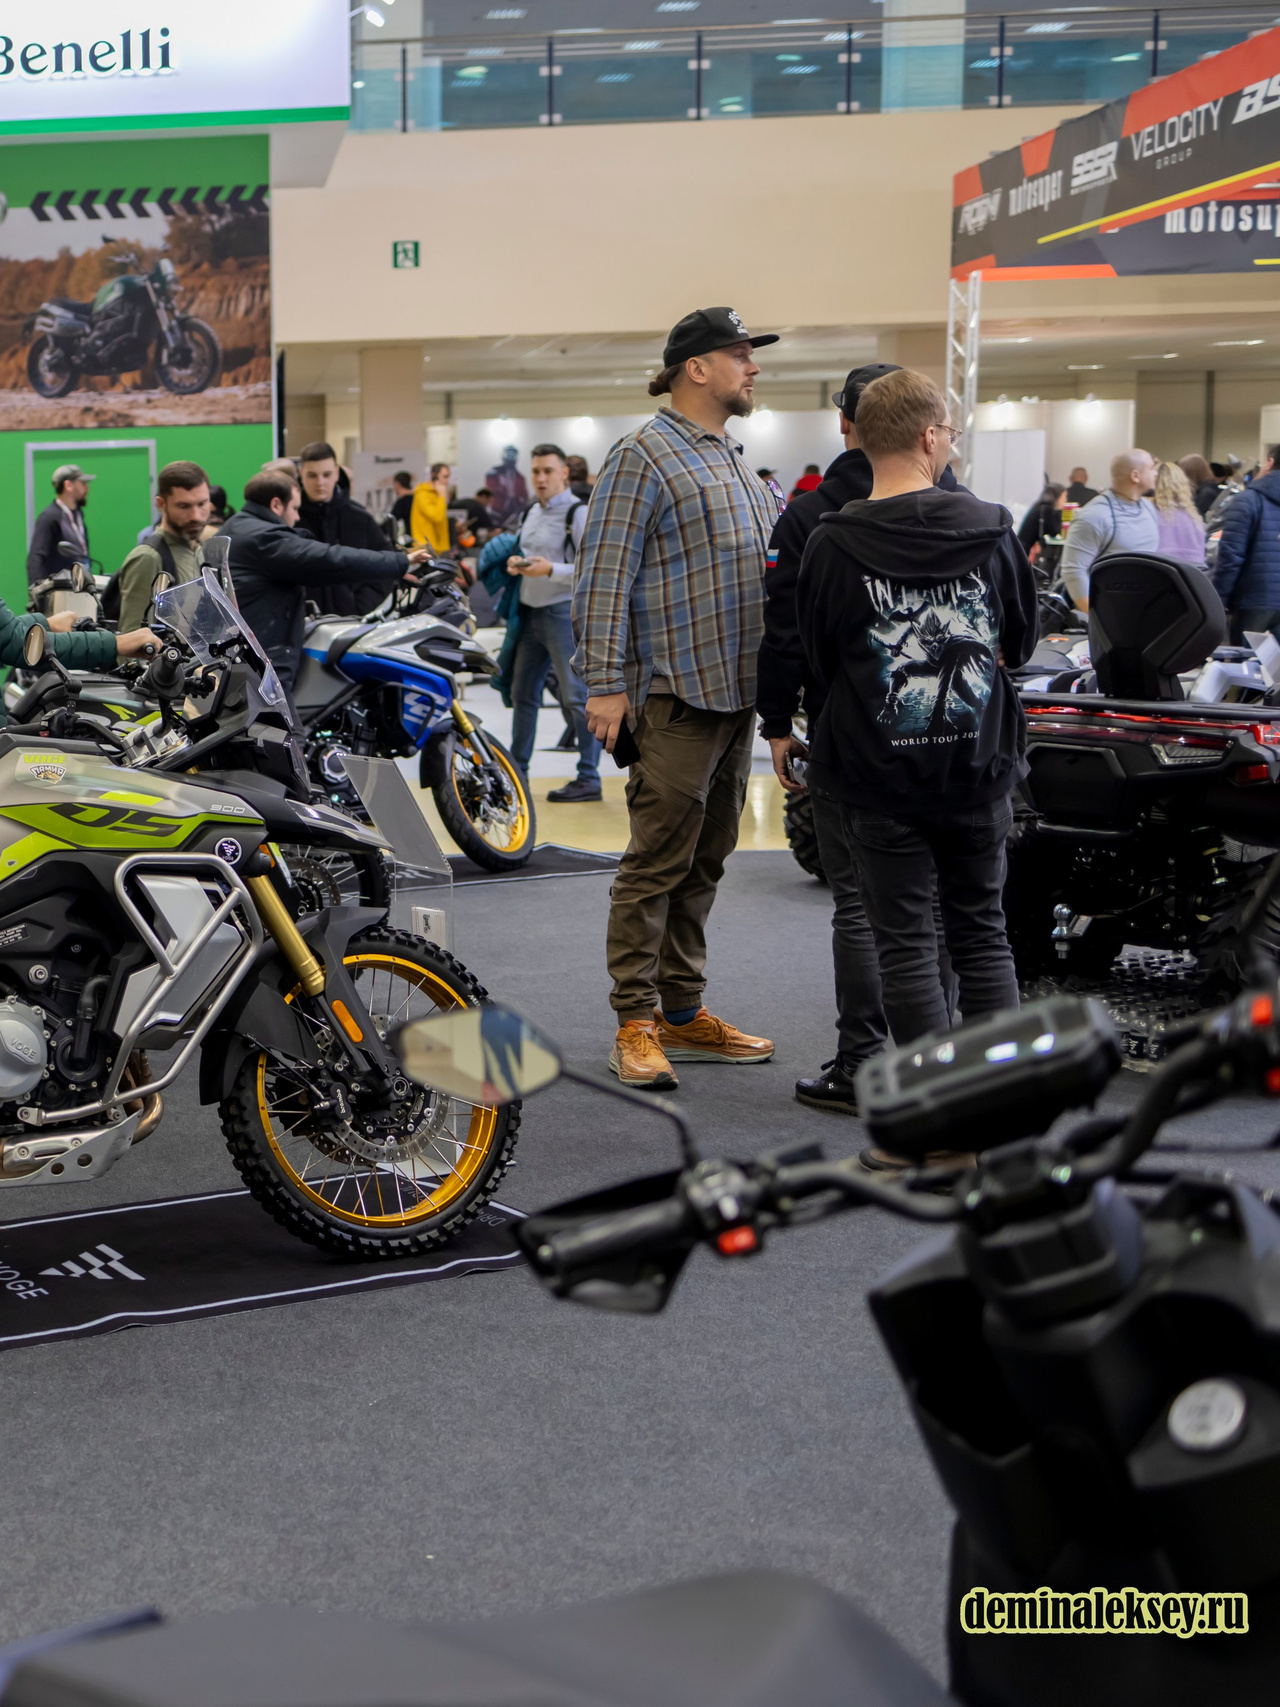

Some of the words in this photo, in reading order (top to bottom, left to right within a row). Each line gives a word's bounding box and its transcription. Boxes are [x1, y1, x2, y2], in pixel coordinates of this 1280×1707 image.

[1130, 96, 1224, 161] VELOCITY
[1070, 141, 1118, 188] SSR
[1155, 148, 1193, 170] GROUP
[891, 737, 929, 747] WORLD
[932, 733, 959, 745] TOUR
[962, 729, 980, 740] 202
[210, 804, 245, 814] 900
[10, 1039, 37, 1060] VOGE
